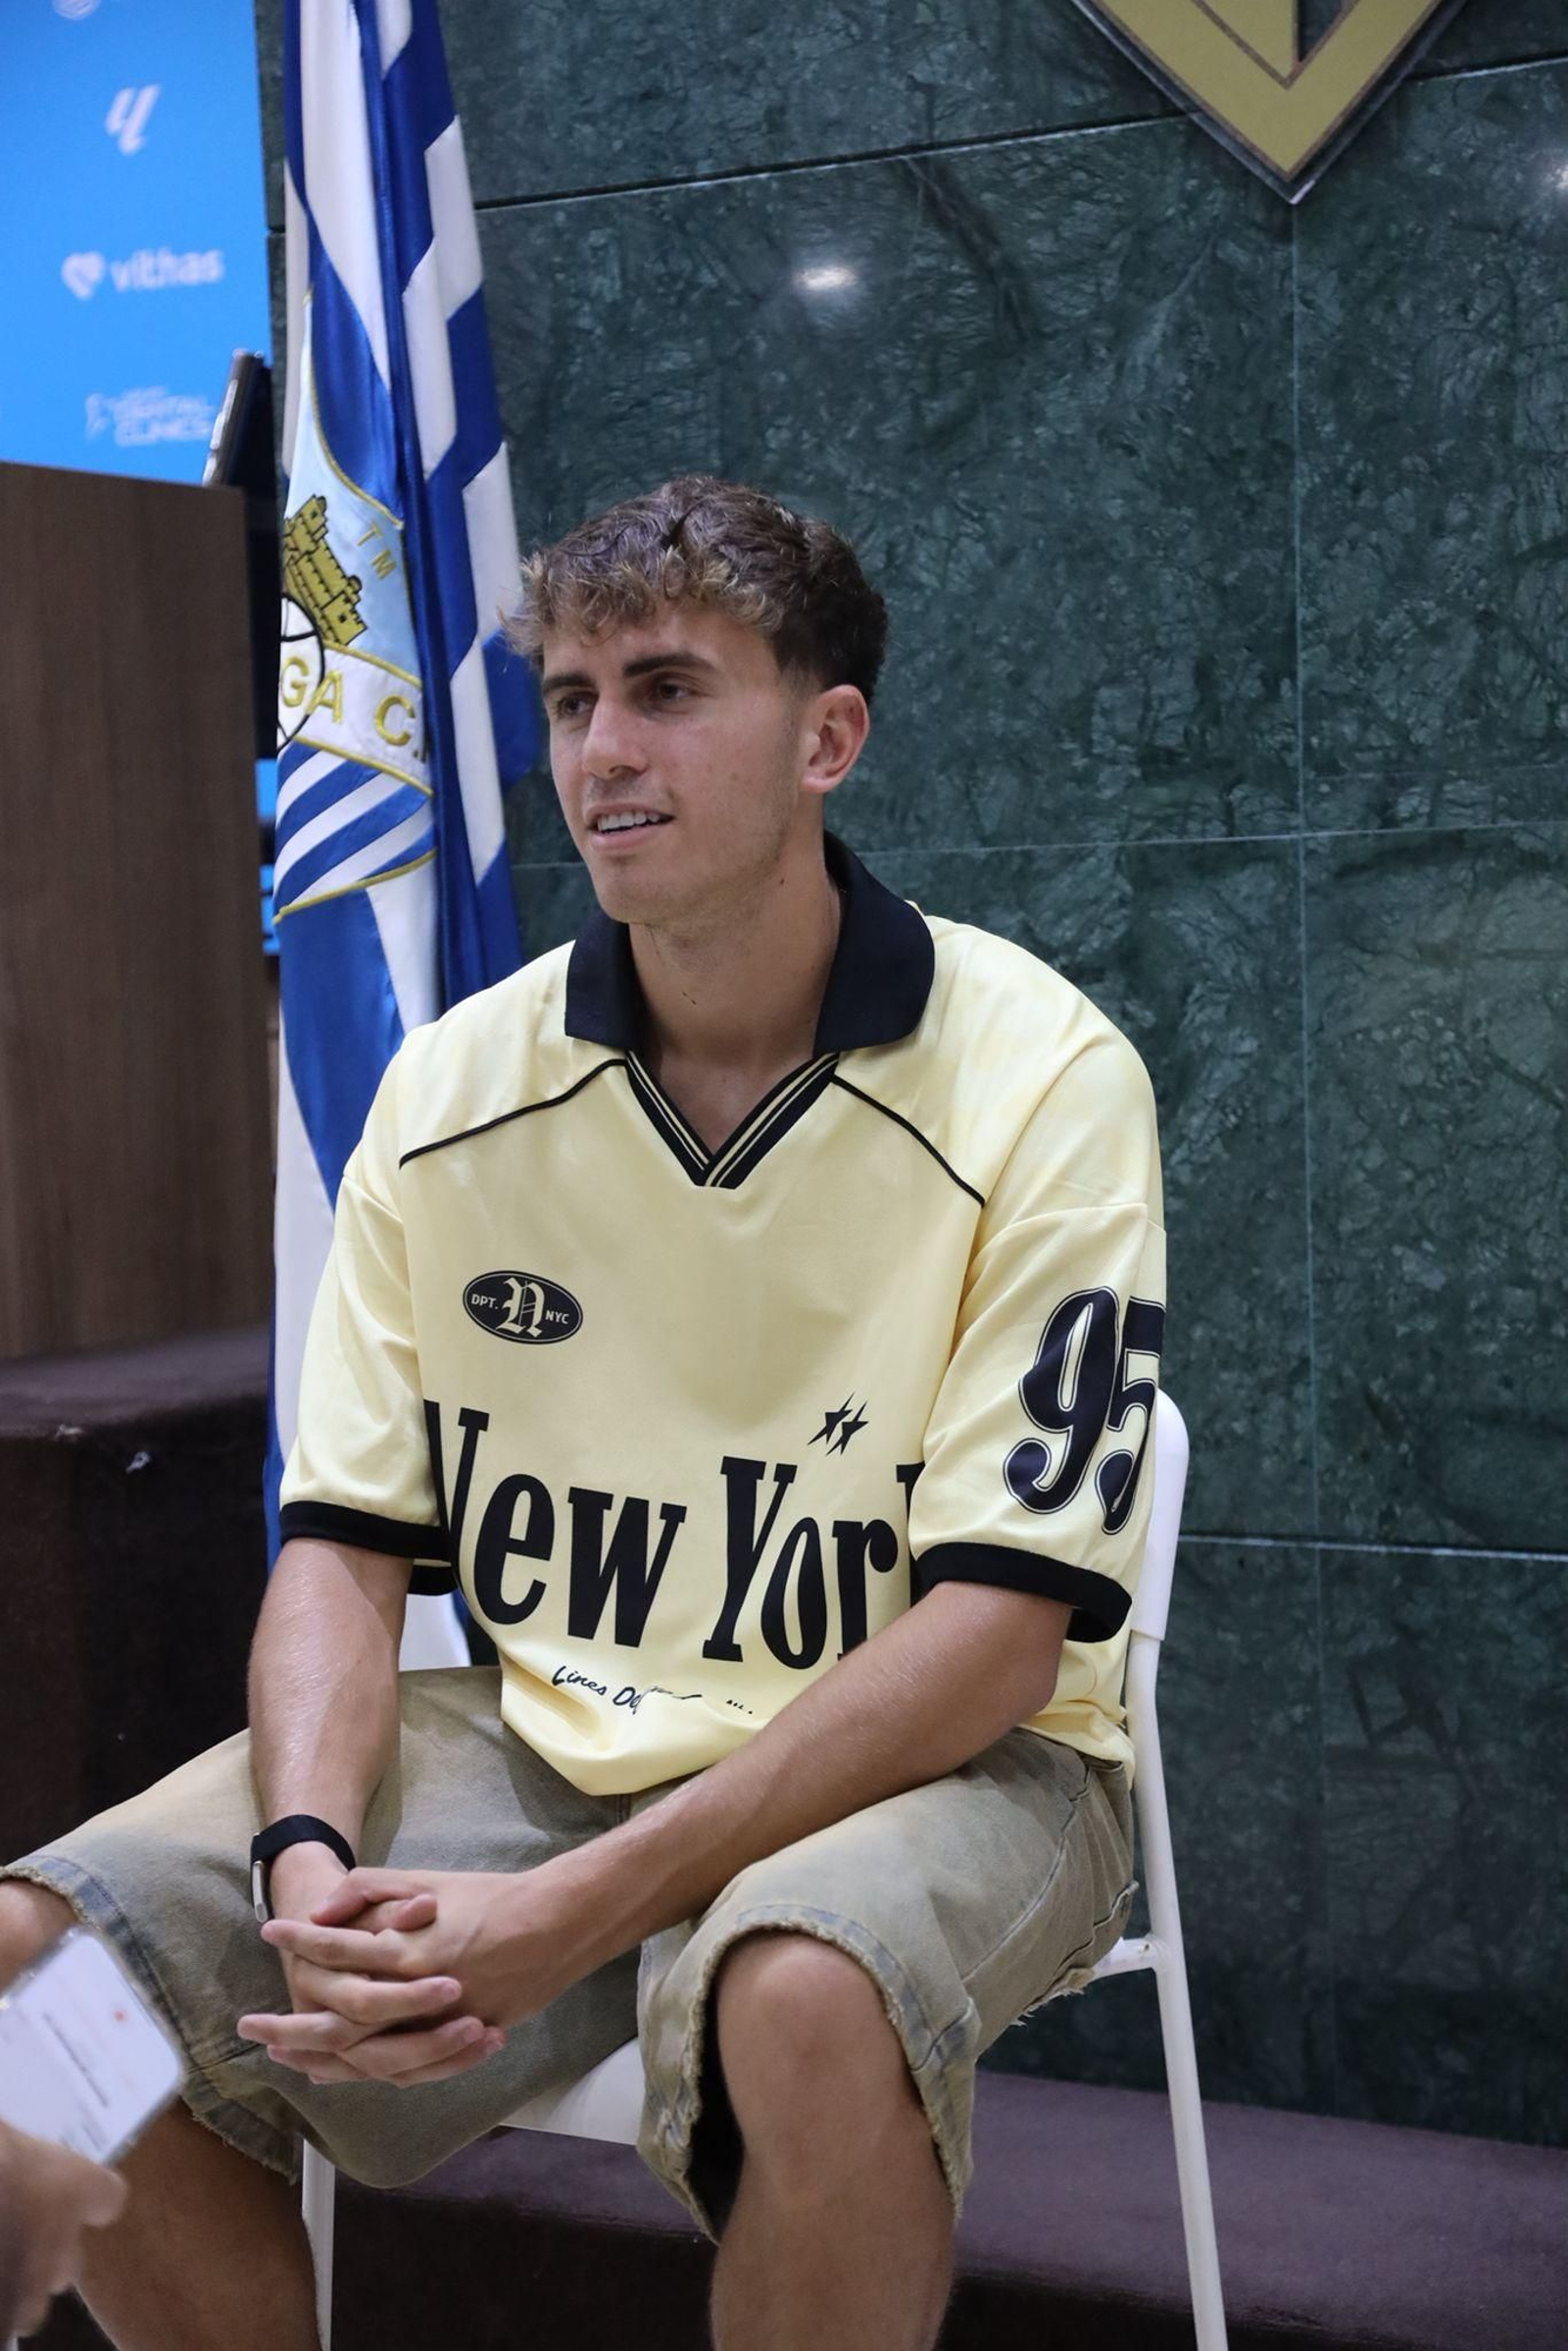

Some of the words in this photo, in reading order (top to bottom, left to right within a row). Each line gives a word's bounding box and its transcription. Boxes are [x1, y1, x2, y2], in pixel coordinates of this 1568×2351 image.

[471, 1294, 499, 1310] DPT.
[545, 1309, 569, 1325] NYC
[1004, 1287, 1166, 1535] 95
[702, 1455, 926, 1670] Yor
[552, 1666, 609, 1696] Lines
